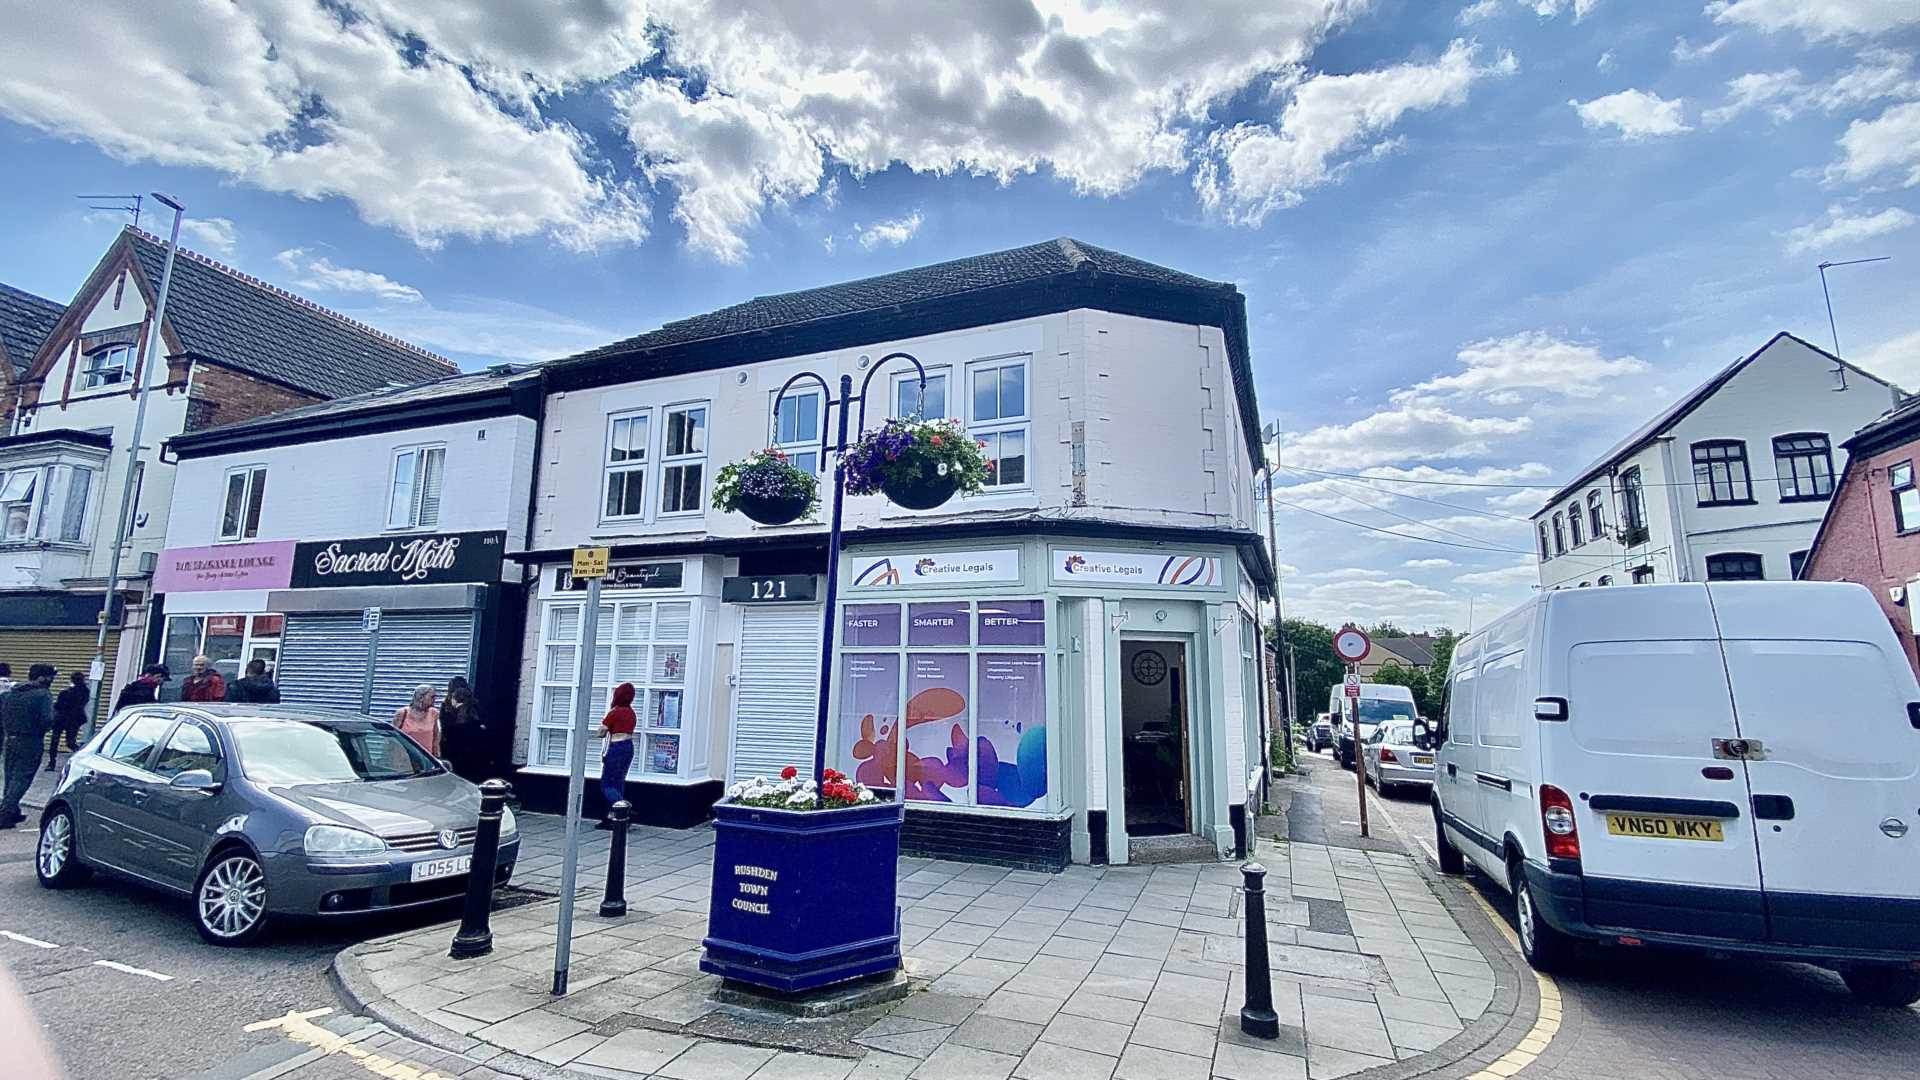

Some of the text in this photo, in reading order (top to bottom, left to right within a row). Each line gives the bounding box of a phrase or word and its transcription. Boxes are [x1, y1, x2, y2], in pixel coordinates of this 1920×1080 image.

[315, 537, 461, 581] Sacred Moth
[922, 562, 994, 574] Creative Legals
[1072, 563, 1143, 575] Creative Legals
[751, 580, 787, 599] 121
[848, 619, 879, 628] FASTER
[913, 618, 955, 627] SMARTER
[984, 617, 1019, 626] BETTER
[1614, 816, 1712, 837] VN60 WKY
[734, 864, 778, 881] RUSHDEN
[739, 882, 768, 896] TOWN
[732, 897, 771, 914] COUNCIL
